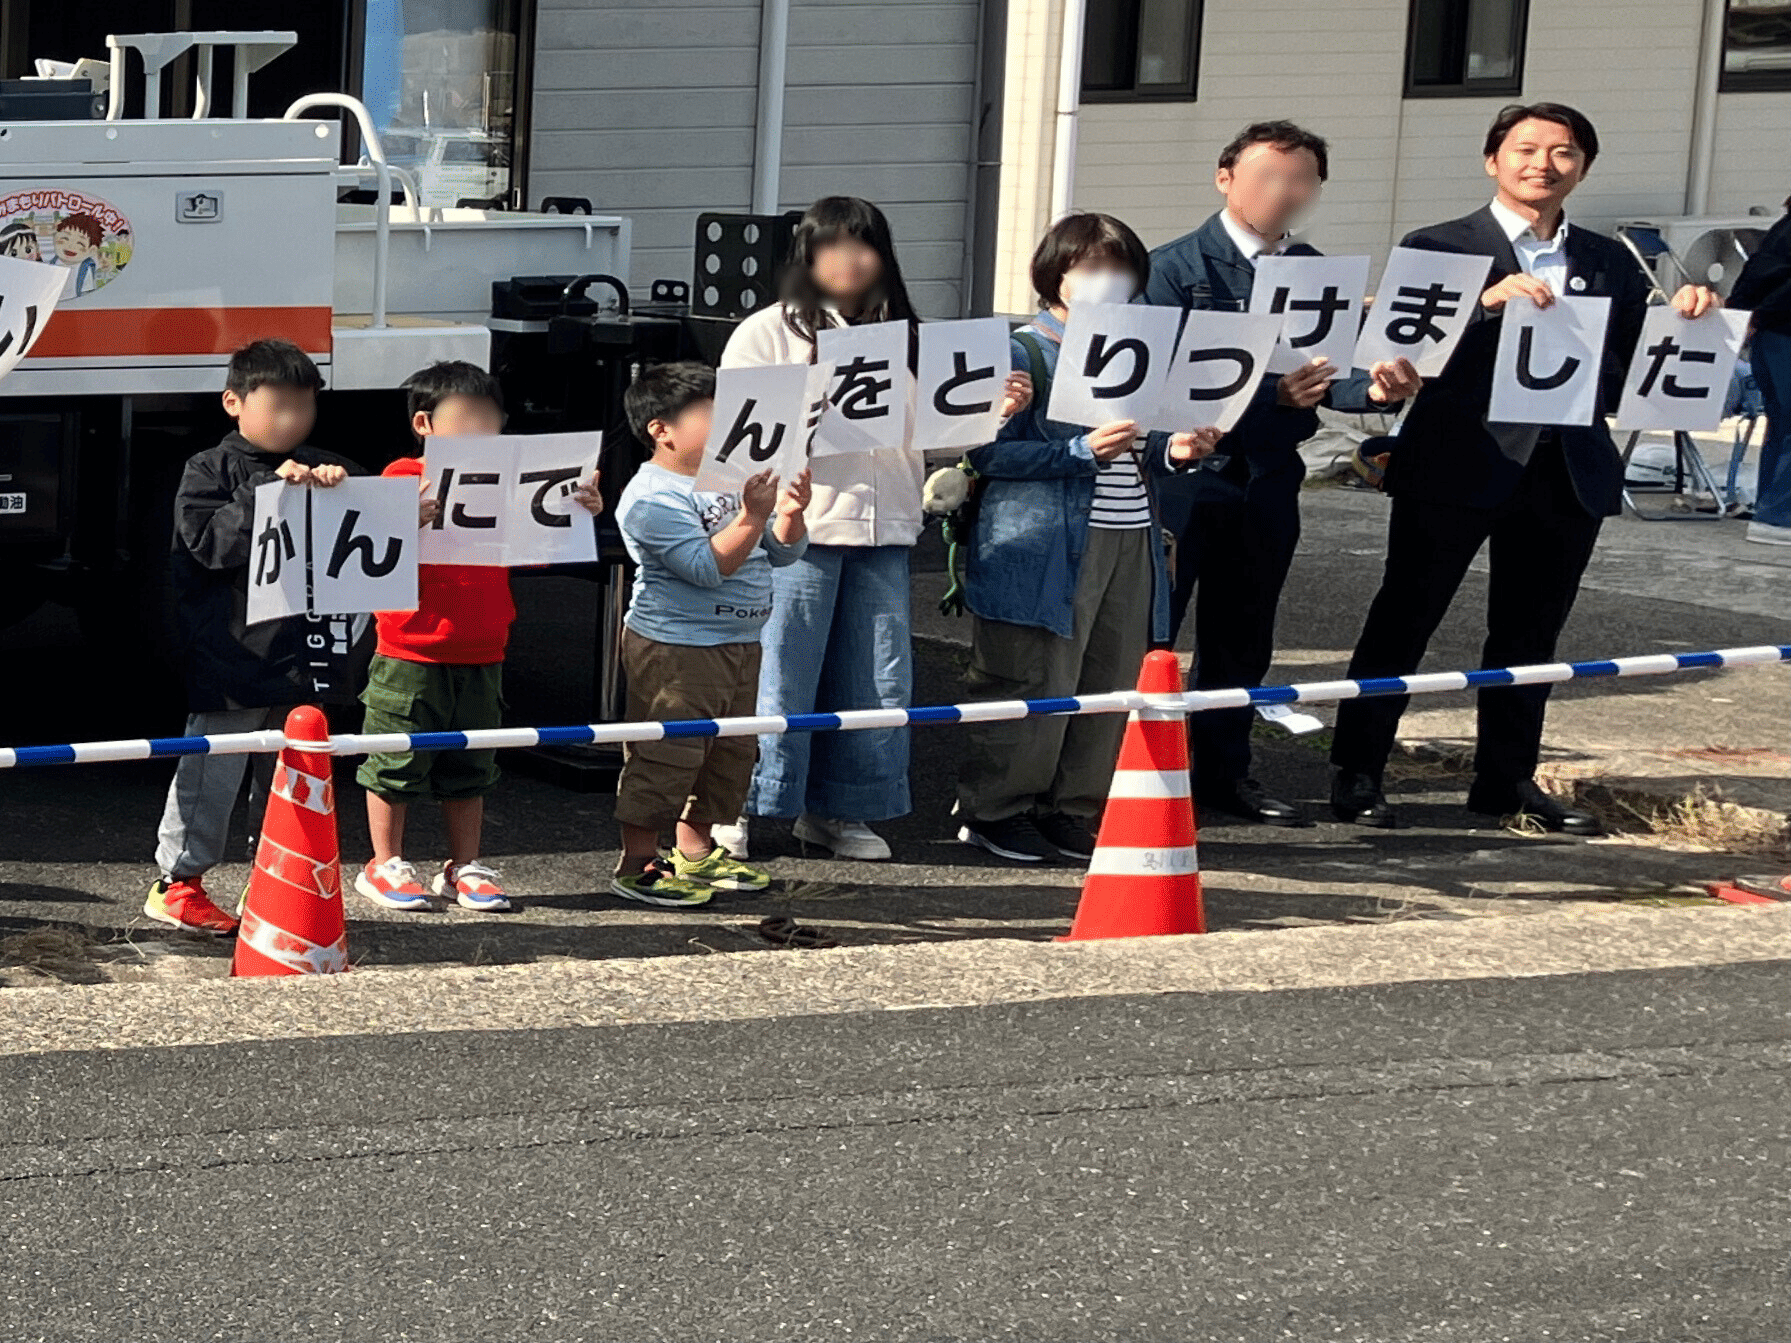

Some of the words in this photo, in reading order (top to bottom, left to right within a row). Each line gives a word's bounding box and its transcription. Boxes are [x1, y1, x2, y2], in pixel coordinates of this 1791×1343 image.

[1270, 287, 1350, 348] け
[1386, 283, 1462, 344] ま
[829, 357, 891, 419] を
[934, 352, 994, 416] と
[1084, 334, 1149, 398] り
[1189, 348, 1254, 401] つ
[1516, 326, 1580, 390] し
[1637, 336, 1716, 398] た
[715, 399, 786, 463] ん
[520, 467, 584, 527] で
[256, 517, 295, 586] か
[326, 509, 402, 579] ん
